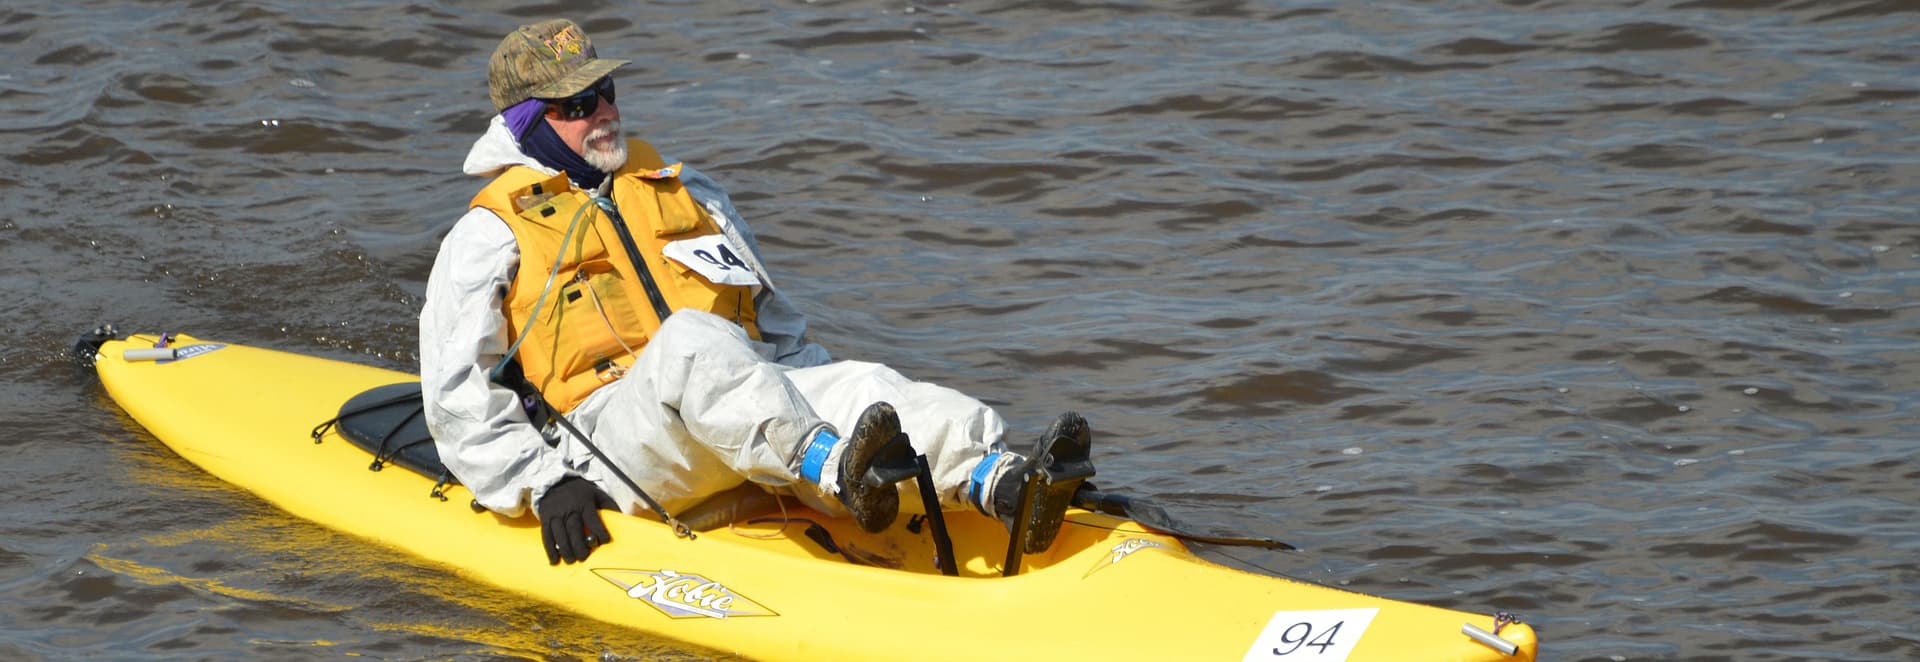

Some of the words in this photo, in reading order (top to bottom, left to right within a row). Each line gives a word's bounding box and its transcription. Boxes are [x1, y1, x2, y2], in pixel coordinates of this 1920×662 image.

[693, 243, 751, 271] 94
[627, 569, 724, 617] Hobie
[1272, 620, 1344, 656] 94
